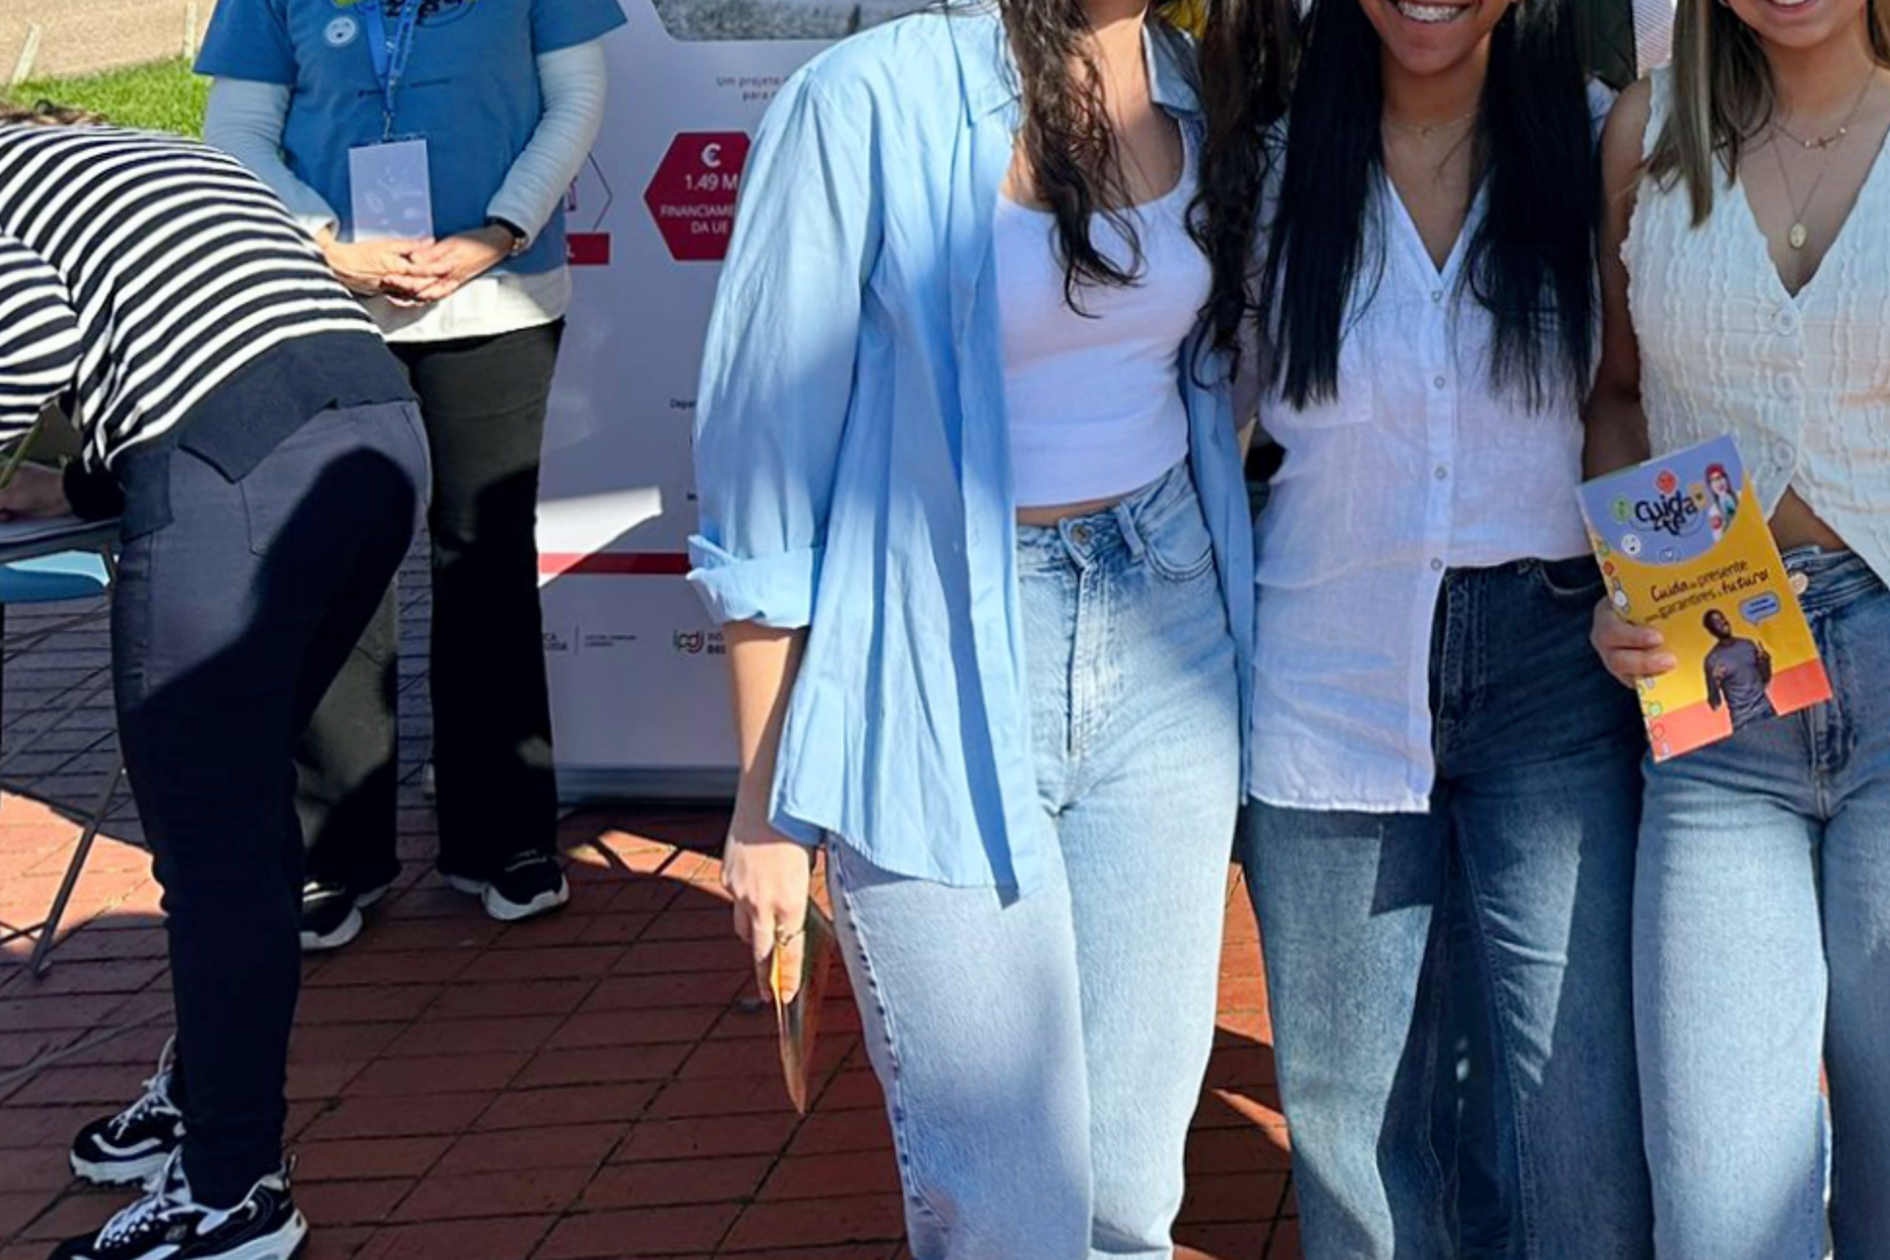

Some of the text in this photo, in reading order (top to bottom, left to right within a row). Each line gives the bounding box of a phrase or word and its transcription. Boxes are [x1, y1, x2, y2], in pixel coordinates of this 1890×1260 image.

[661, 204, 734, 217] FINANCIAME
[691, 220, 729, 234] DA UE
[1635, 490, 1698, 522] Cuida
[1651, 581, 1689, 602] Cuida
